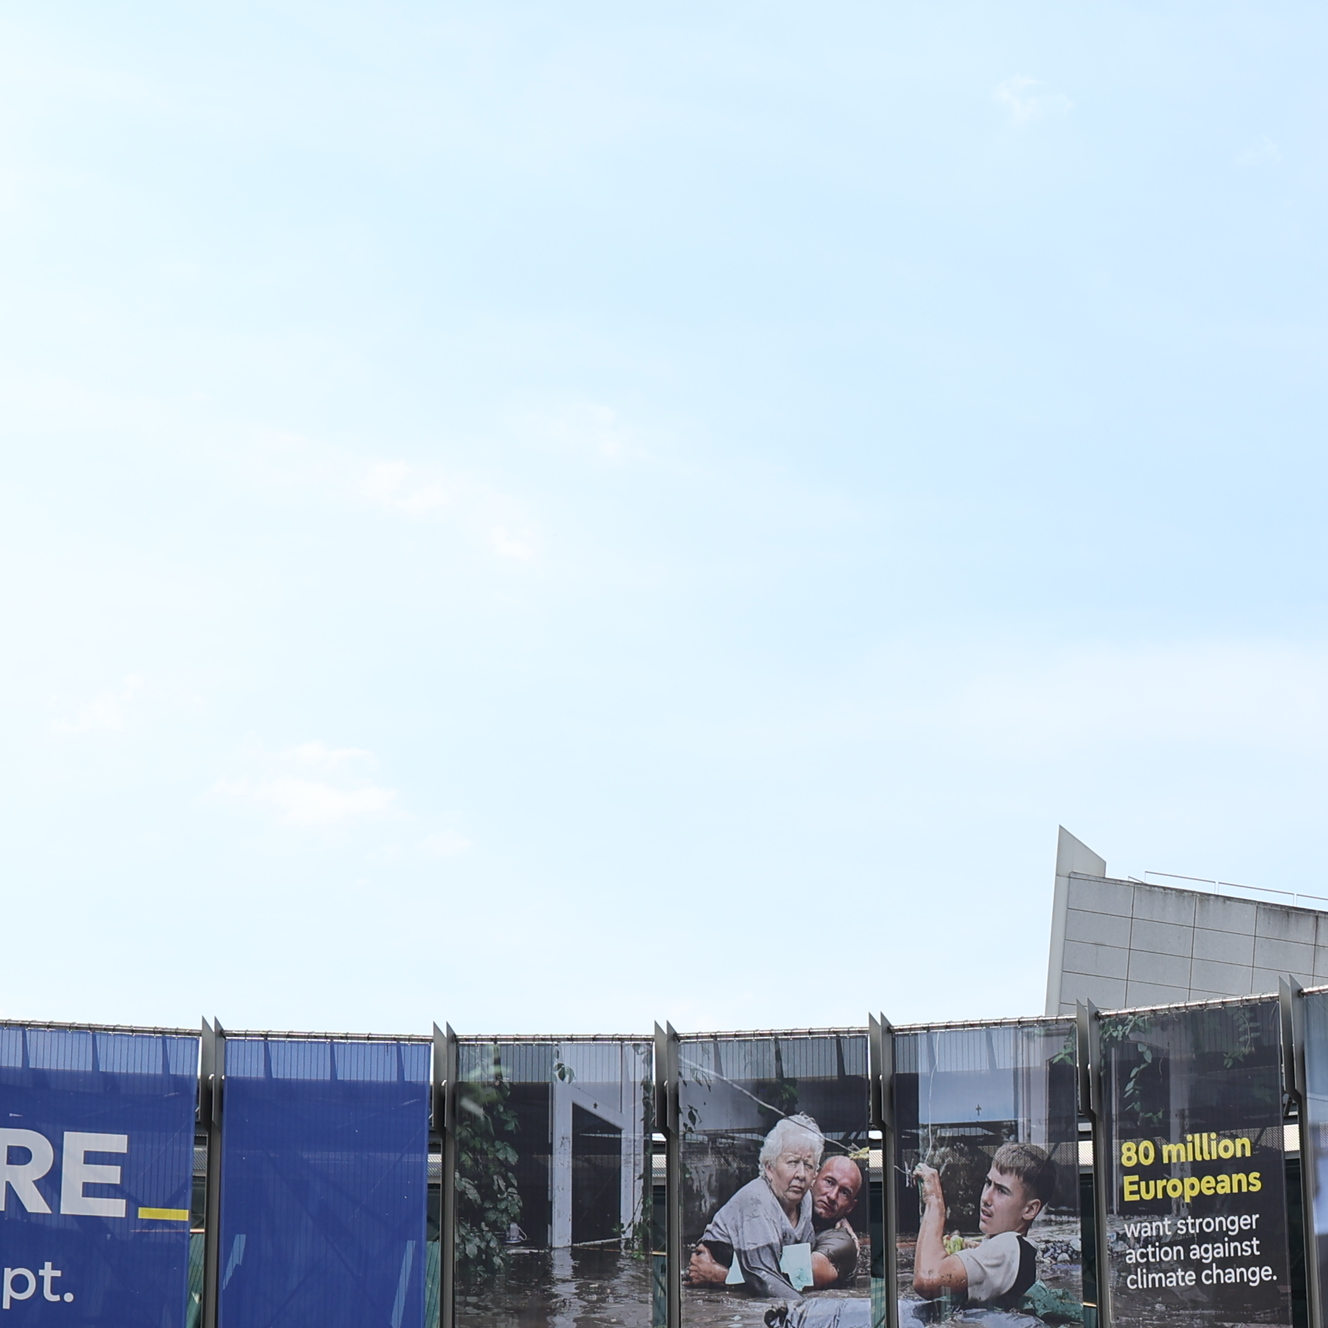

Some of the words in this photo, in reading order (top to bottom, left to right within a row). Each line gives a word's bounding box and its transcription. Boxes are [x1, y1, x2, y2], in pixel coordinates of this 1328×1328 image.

[1121, 1140, 1155, 1168] 80
[1162, 1132, 1252, 1164] million
[1123, 1171, 1262, 1203] Europeans
[1124, 1217, 1172, 1238] want
[1177, 1213, 1260, 1235] stronger
[1125, 1242, 1184, 1264] action
[1189, 1237, 1260, 1263] against
[1126, 1268, 1197, 1290] climate
[1201, 1263, 1277, 1287] change.
